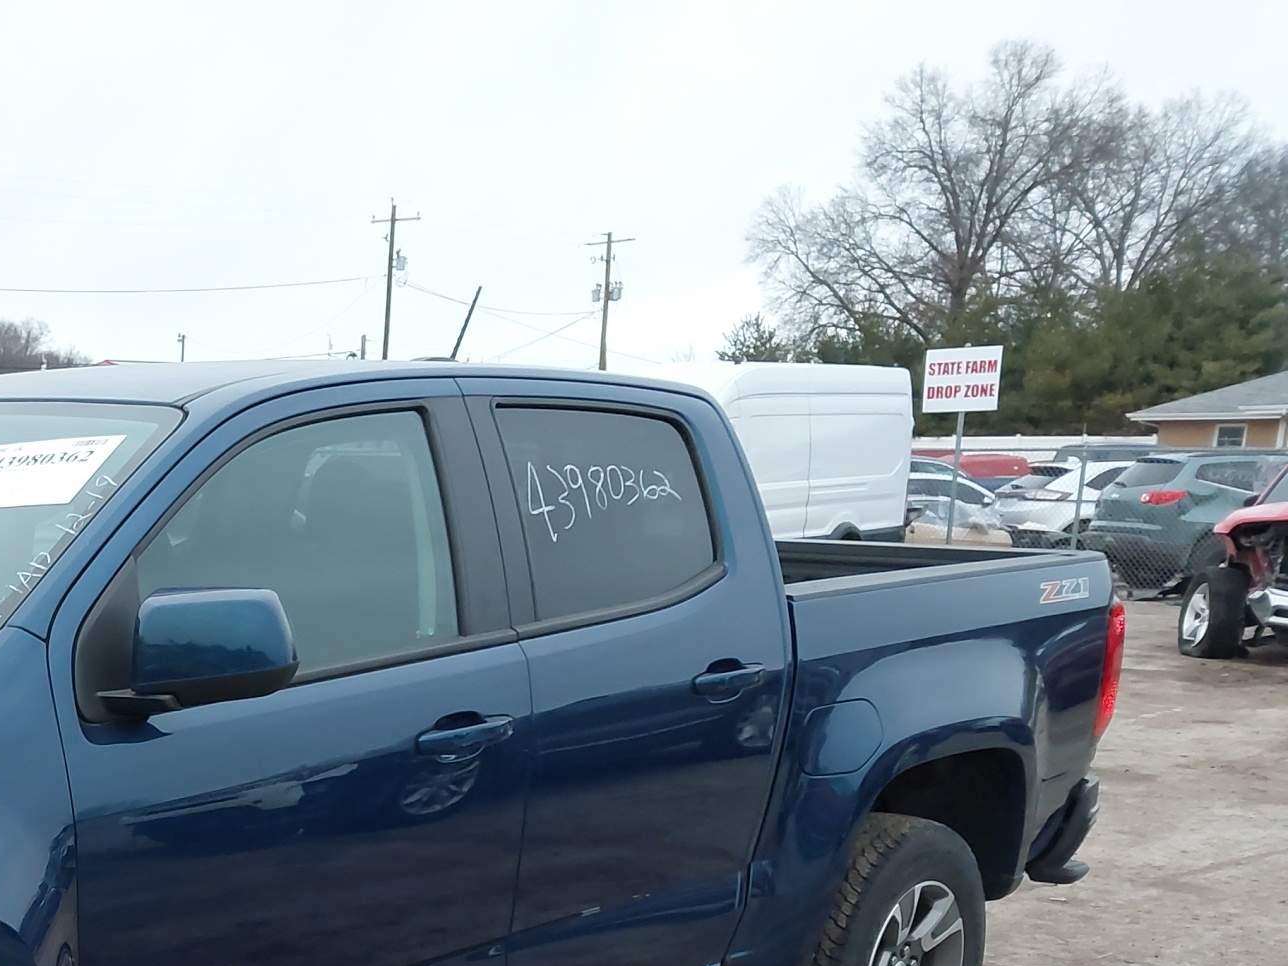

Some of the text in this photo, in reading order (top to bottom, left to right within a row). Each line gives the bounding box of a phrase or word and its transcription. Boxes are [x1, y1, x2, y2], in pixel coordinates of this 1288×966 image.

[928, 359, 998, 376] STATE FARM
[927, 383, 996, 400] DROP ZONE
[527, 461, 682, 542] 43980362
[1039, 576, 1090, 605] Z71
